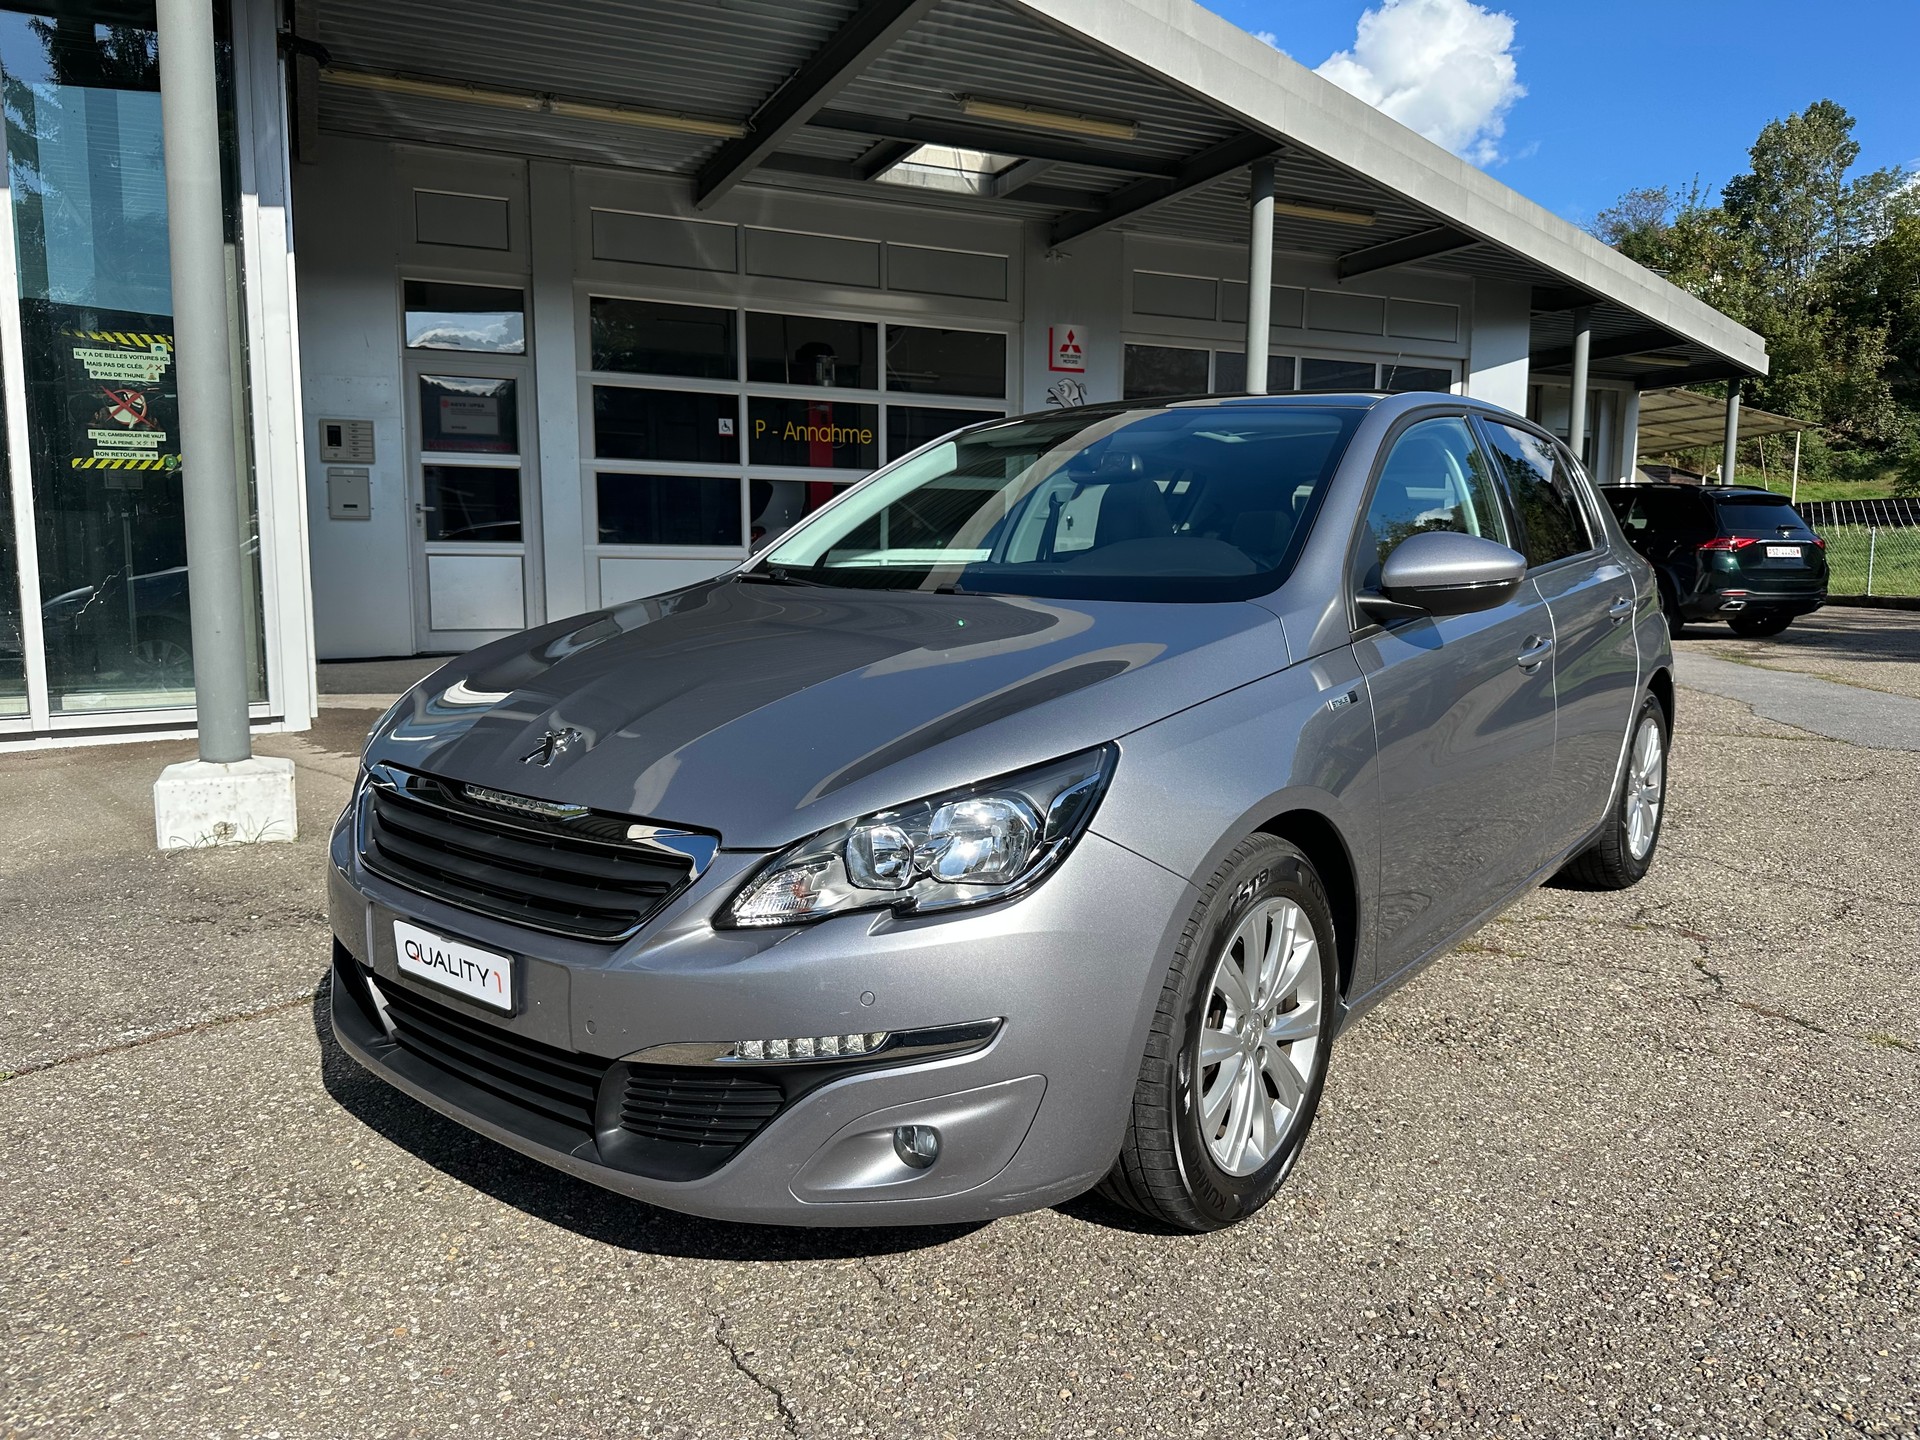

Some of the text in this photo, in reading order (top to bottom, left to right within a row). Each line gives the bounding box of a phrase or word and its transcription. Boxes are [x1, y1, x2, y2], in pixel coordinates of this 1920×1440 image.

[755, 420, 766, 439] P
[783, 421, 872, 445] Annahme
[1332, 696, 1349, 708] STYLE
[404, 939, 502, 993] QUALITY 1
